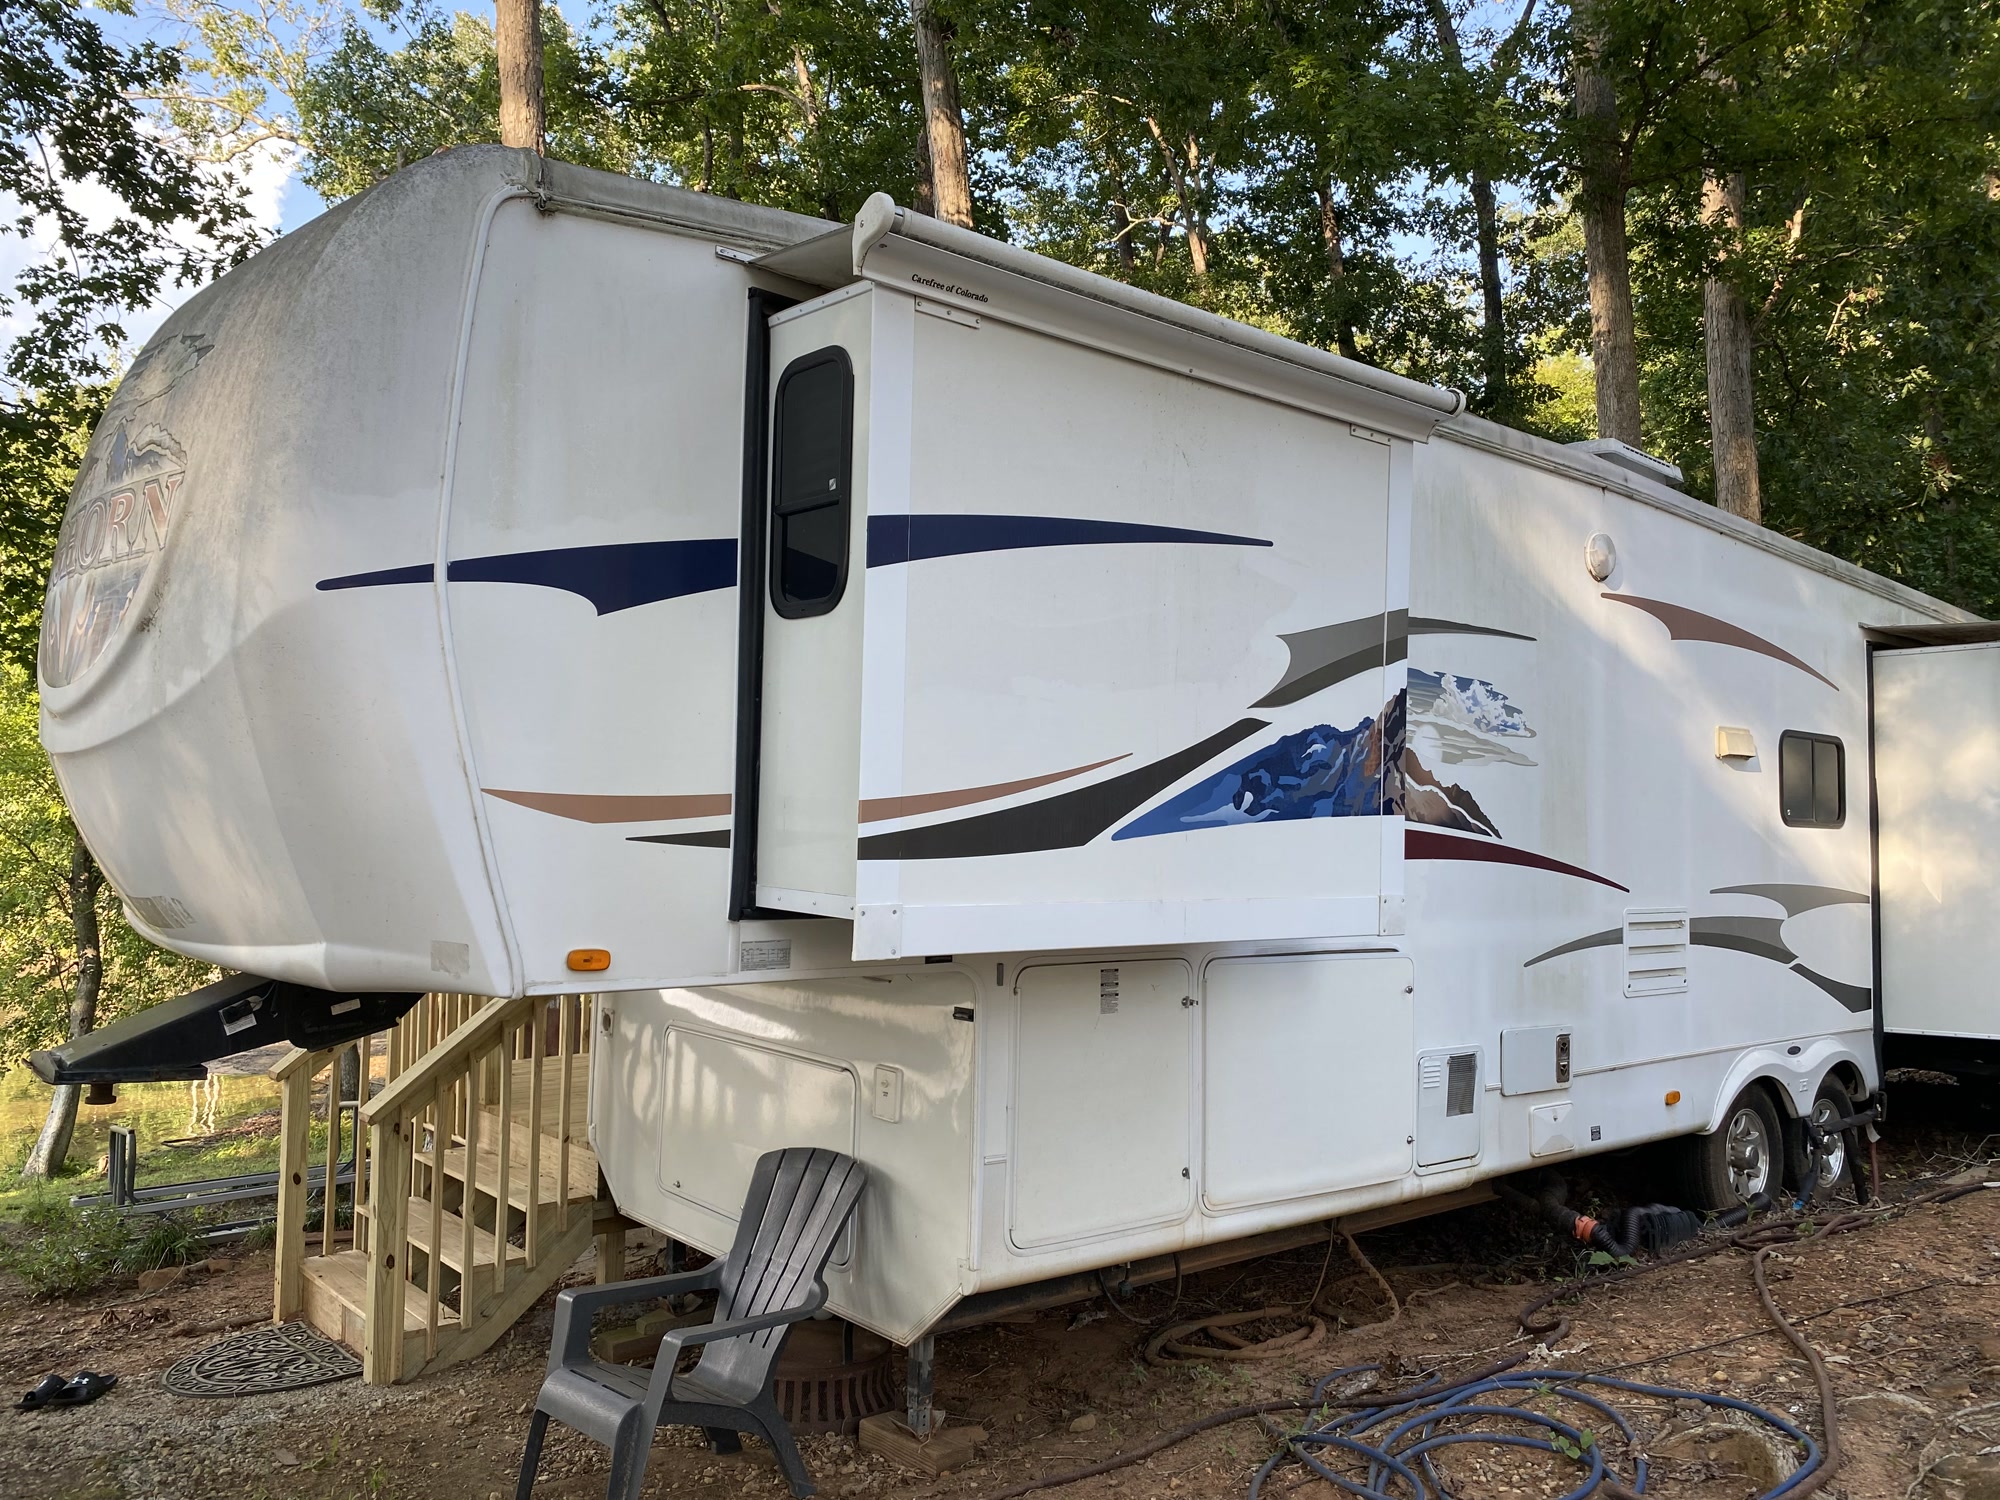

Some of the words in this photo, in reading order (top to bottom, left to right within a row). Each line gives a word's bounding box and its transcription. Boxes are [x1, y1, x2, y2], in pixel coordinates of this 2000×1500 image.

[911, 273, 945, 290] Carefree
[945, 285, 956, 293] of
[955, 286, 989, 303] Colorado
